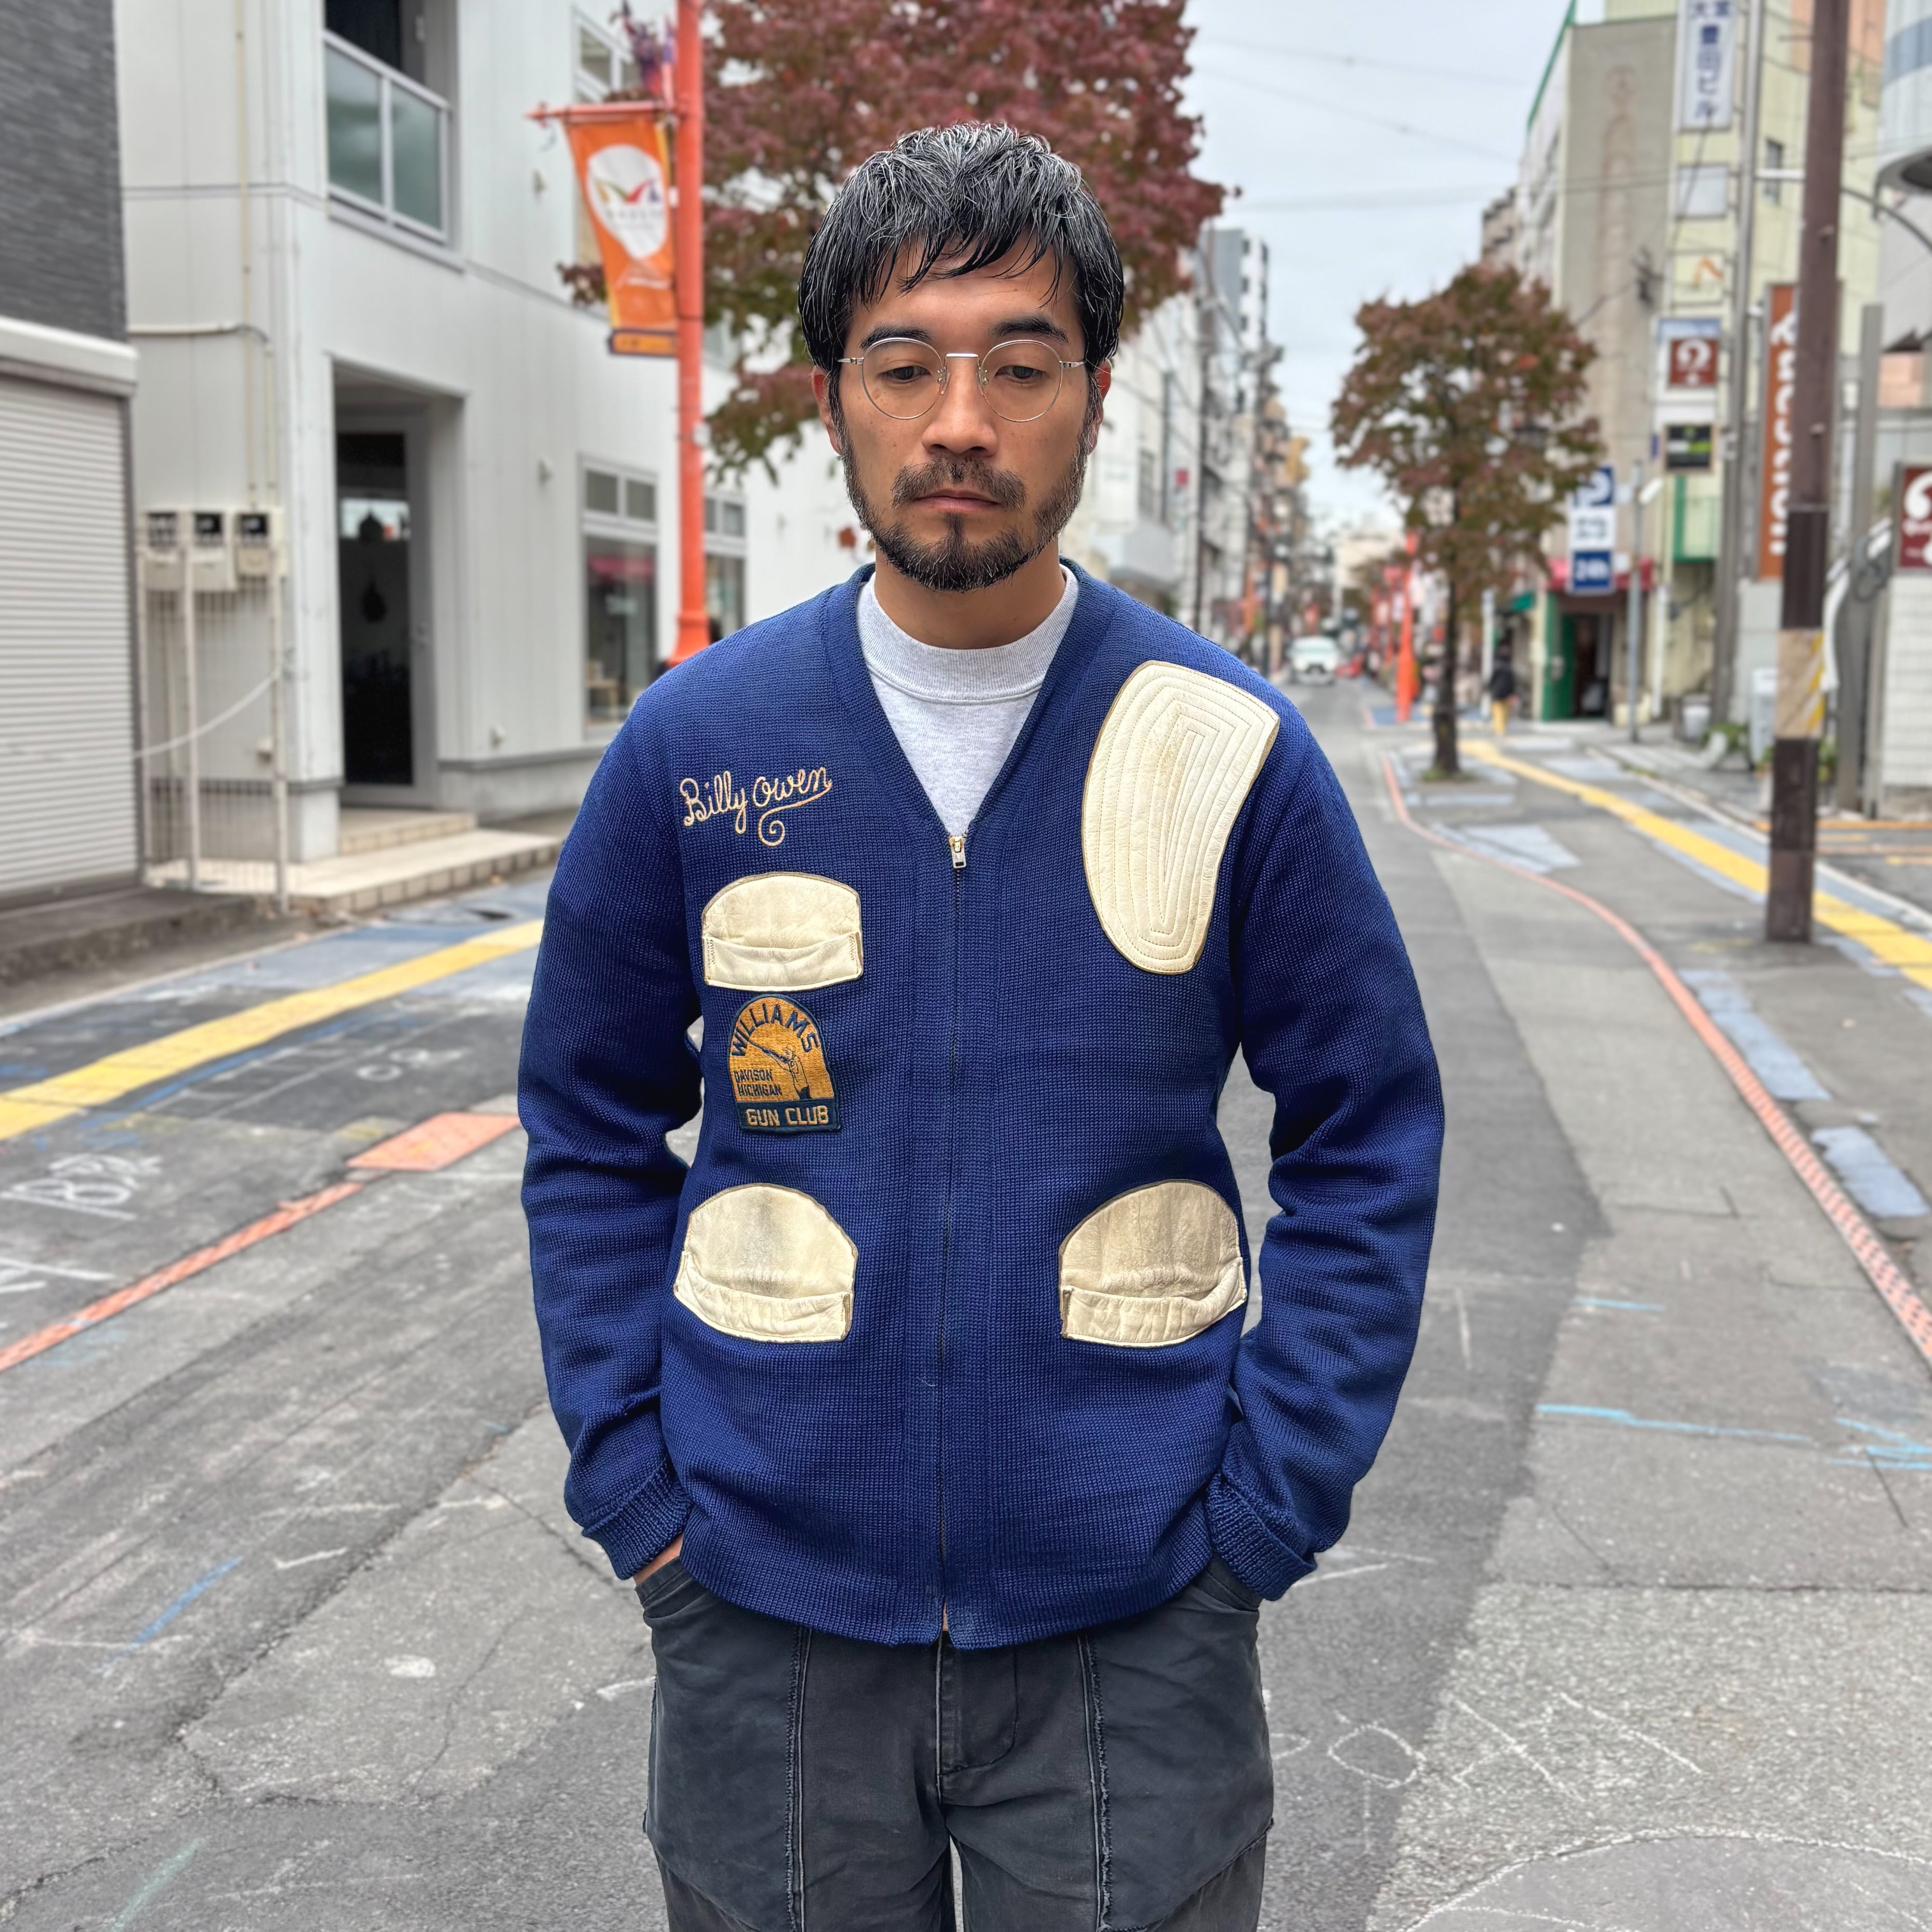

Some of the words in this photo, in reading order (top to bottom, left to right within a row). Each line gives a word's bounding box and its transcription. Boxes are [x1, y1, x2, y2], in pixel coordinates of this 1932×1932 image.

[680, 770, 747, 834] Billy
[731, 1003, 820, 1056] WILLIAMS
[733, 1069, 773, 1083] DAVISON
[737, 1083, 782, 1097] MICHIGAN
[746, 1108, 780, 1127] GUN
[785, 1105, 829, 1125] CLUB
